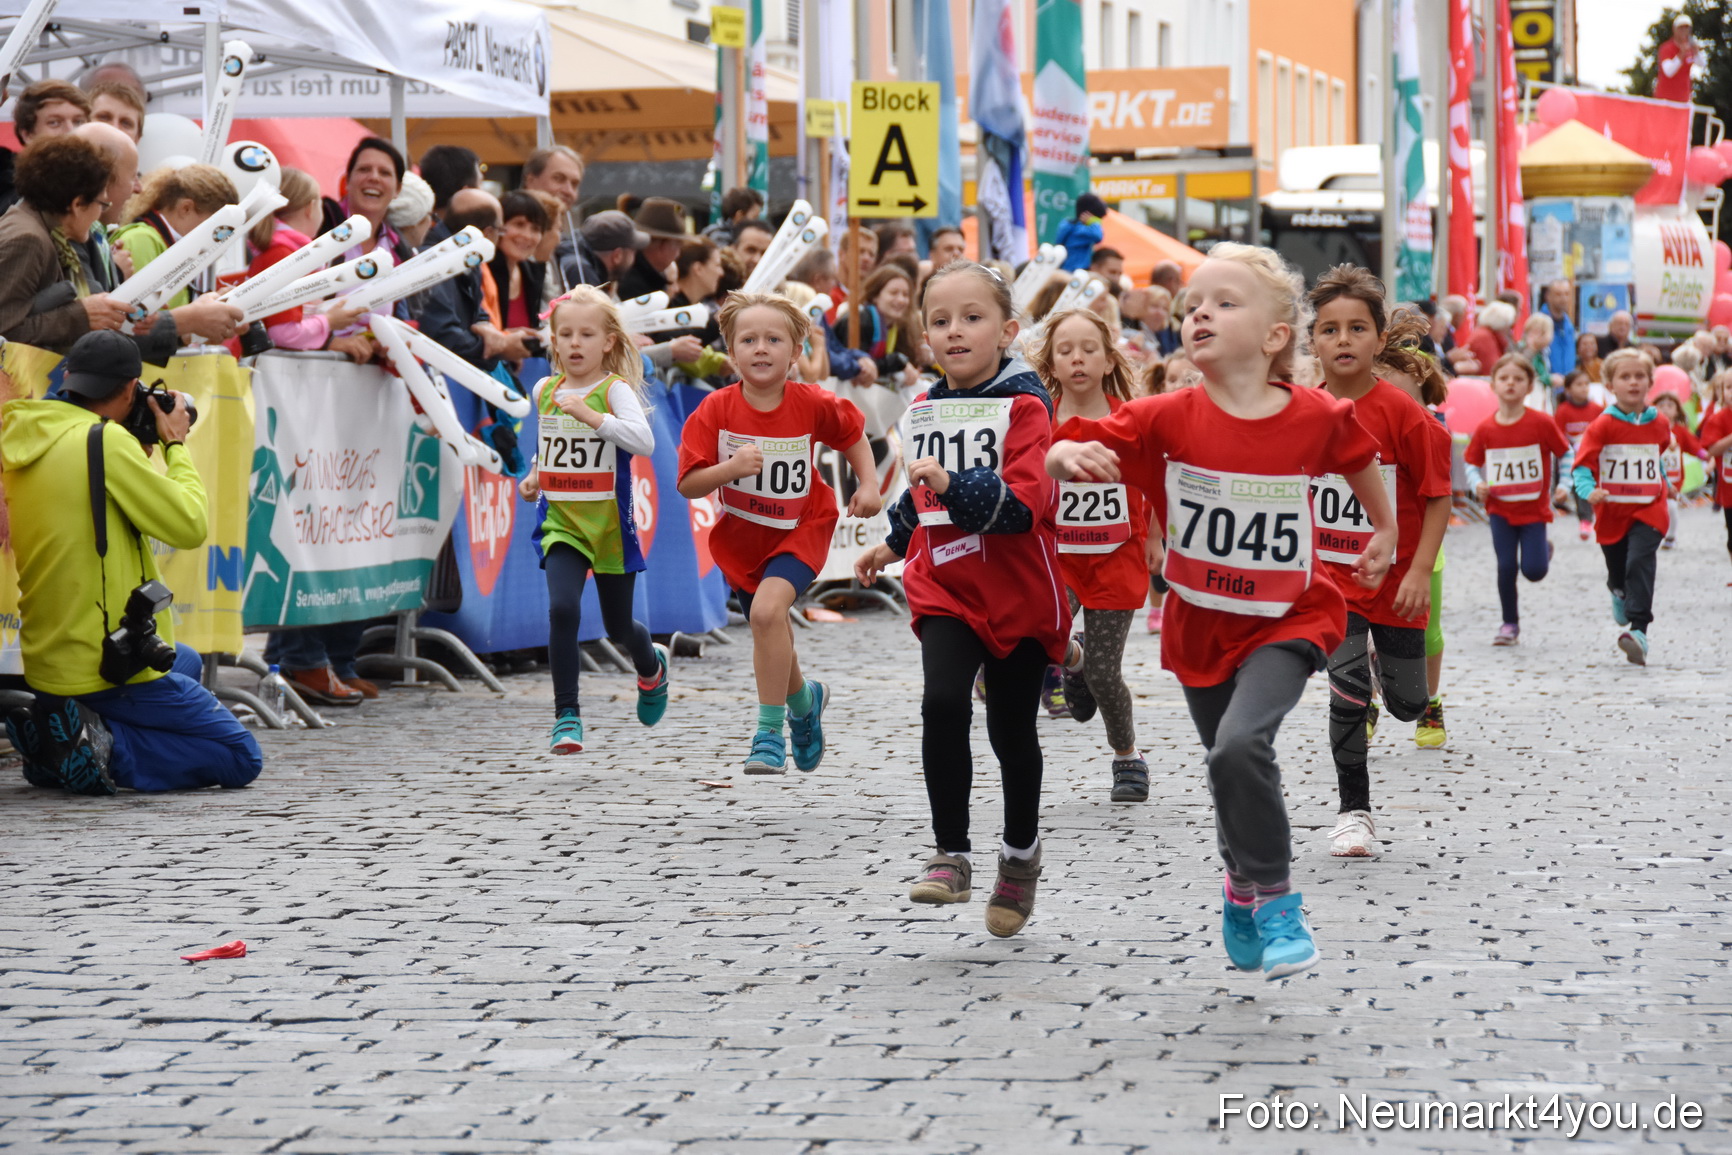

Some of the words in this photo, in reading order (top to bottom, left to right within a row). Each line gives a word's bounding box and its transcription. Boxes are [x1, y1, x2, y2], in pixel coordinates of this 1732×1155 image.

[485, 25, 532, 85] Neumarkt
[863, 87, 930, 111] Block
[869, 123, 919, 187] A
[1659, 216, 1704, 268] AVIA
[1659, 270, 1704, 310] Pellets
[940, 403, 1000, 419] BOCK
[543, 437, 606, 469] 7257
[763, 439, 807, 453] BOCK
[913, 428, 998, 473] 7013
[1493, 459, 1539, 482] 7415
[1606, 458, 1656, 480] 7118
[548, 476, 594, 489] Marlene
[1178, 478, 1222, 497] NeuerMarkt
[1231, 480, 1303, 499] BOCK
[749, 498, 786, 517] Paula
[1056, 529, 1109, 542] Felicitas
[1180, 498, 1299, 563] 7045
[1320, 532, 1359, 551] Marie
[945, 543, 967, 557] DEHN
[1206, 569, 1256, 596] Frida
